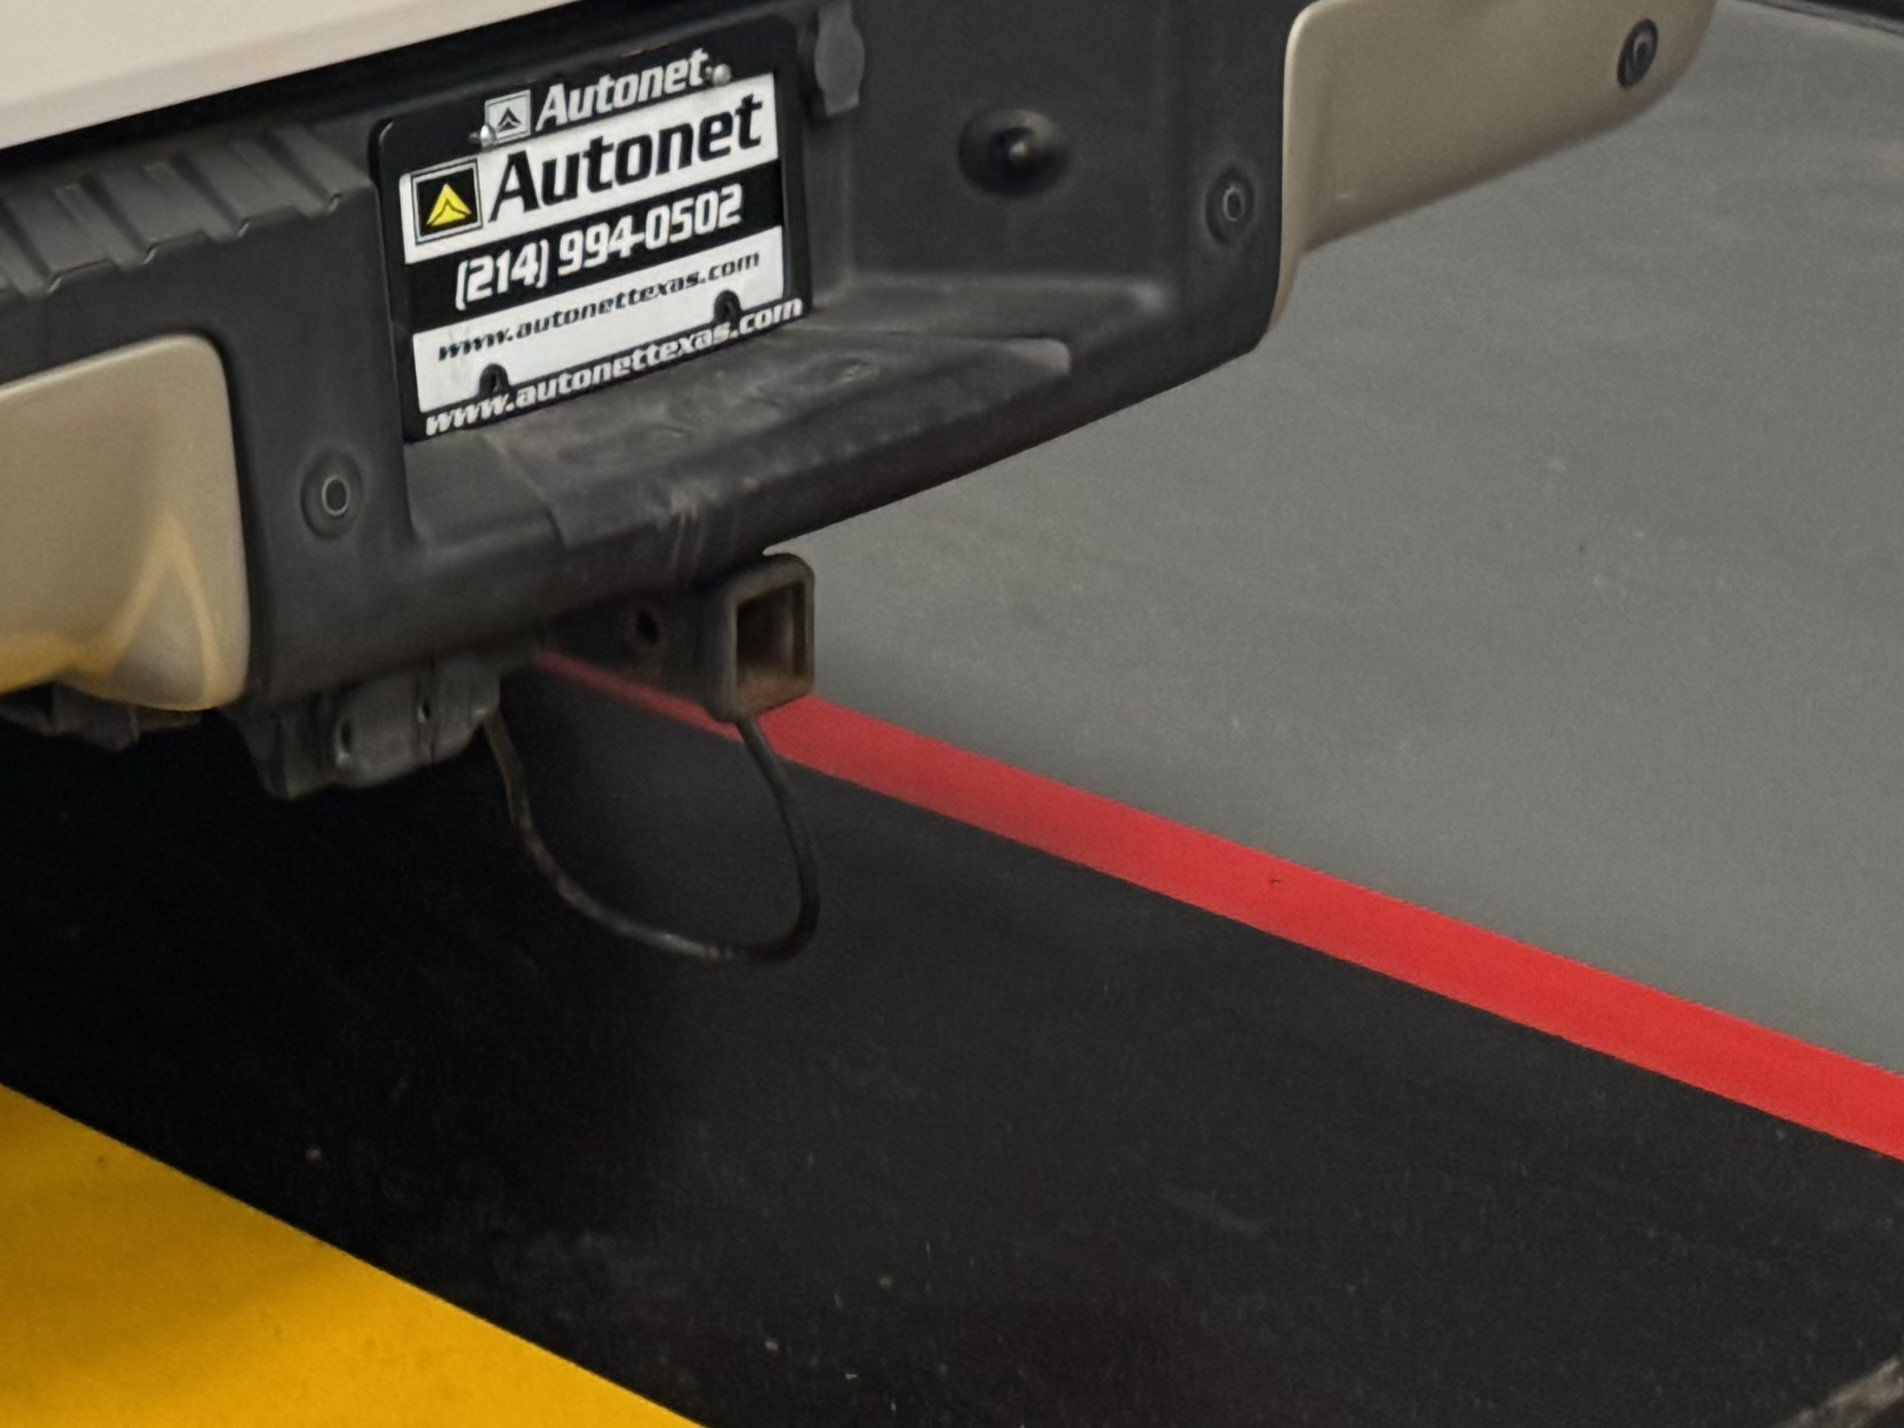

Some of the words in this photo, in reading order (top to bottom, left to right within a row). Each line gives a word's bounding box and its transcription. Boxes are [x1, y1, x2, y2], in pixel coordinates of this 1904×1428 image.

[535, 48, 709, 132] Autonet
[488, 95, 763, 223] Autonet
[438, 251, 761, 361] www.autonettexas.com
[454, 240, 550, 311] (214)
[557, 184, 744, 277] 994-0502
[425, 298, 803, 437] www.autonettexas.com
